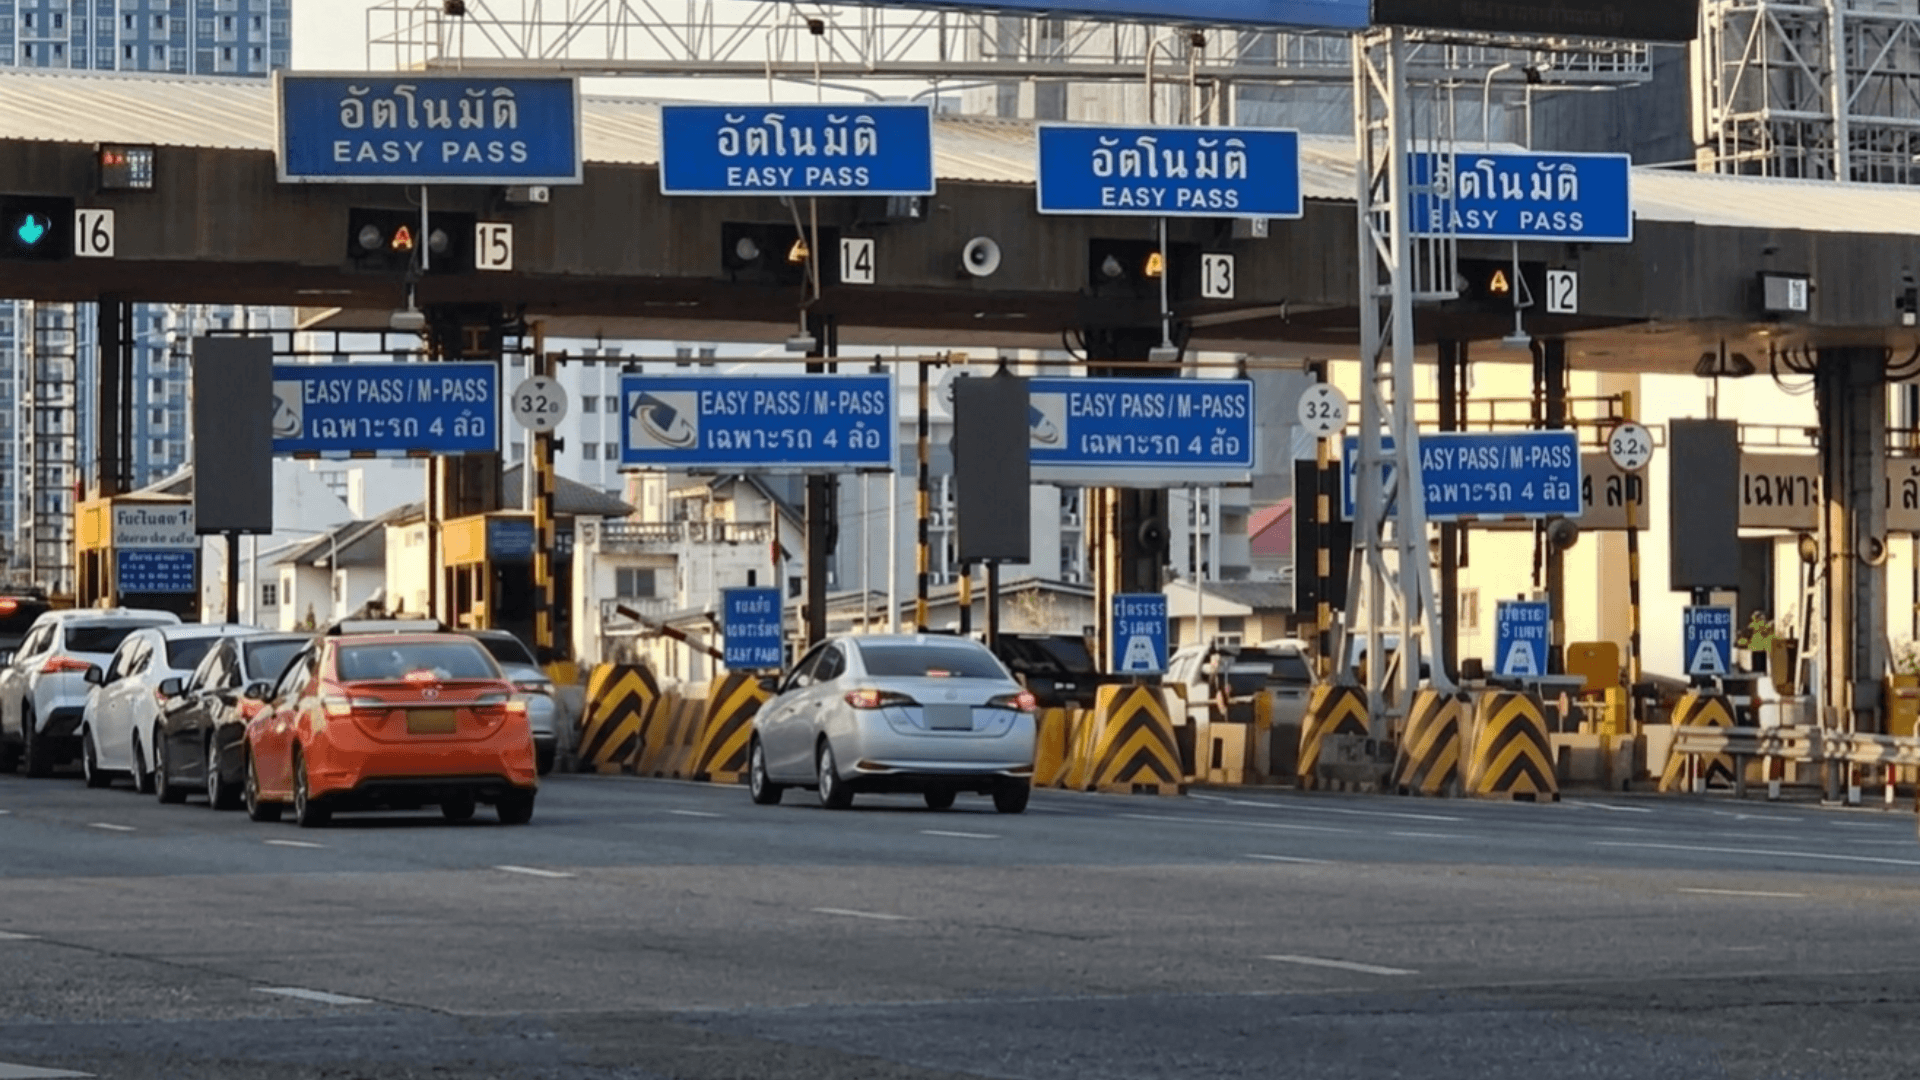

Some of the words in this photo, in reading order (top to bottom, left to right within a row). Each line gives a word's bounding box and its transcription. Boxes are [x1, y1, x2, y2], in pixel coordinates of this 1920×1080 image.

[340, 84, 518, 130] อัตโนมัติ
[717, 112, 878, 157] อัตโนมัติ
[333, 140, 425, 164] EASY
[441, 140, 529, 164] PASS
[1092, 135, 1247, 180] อัตโนมัติ
[726, 166, 794, 187] EASY
[805, 166, 870, 187] PASS
[1101, 186, 1167, 208] EASY
[1176, 187, 1240, 209] PASS
[78, 212, 111, 254] 16
[1519, 210, 1584, 232] PASS
[478, 225, 511, 267] 15
[843, 242, 873, 280] 14
[1204, 257, 1231, 296] 13
[1549, 272, 1576, 310] 12
[304, 378, 353, 405] EASY
[357, 378, 404, 404] PASS
[417, 377, 489, 403] M-PASS
[700, 389, 749, 416] EASY
[753, 389, 801, 416] PASS
[813, 388, 886, 416] M-PASS
[1069, 392, 1117, 418] EASY
[1120, 392, 1166, 419] PASS
[1176, 393, 1246, 419] M-PASS
[311, 416, 420, 439] เฉพาะรถ
[428, 416, 445, 437] 4
[707, 428, 813, 451] เฉพาะรถ
[822, 427, 839, 450] 4
[1081, 433, 1180, 456] เฉพาะรถ
[1187, 435, 1203, 456] 4
[1422, 448, 1455, 471] ASY
[1458, 447, 1500, 470] PASS
[1509, 444, 1572, 470] M-PASS
[1520, 481, 1535, 501] 4
